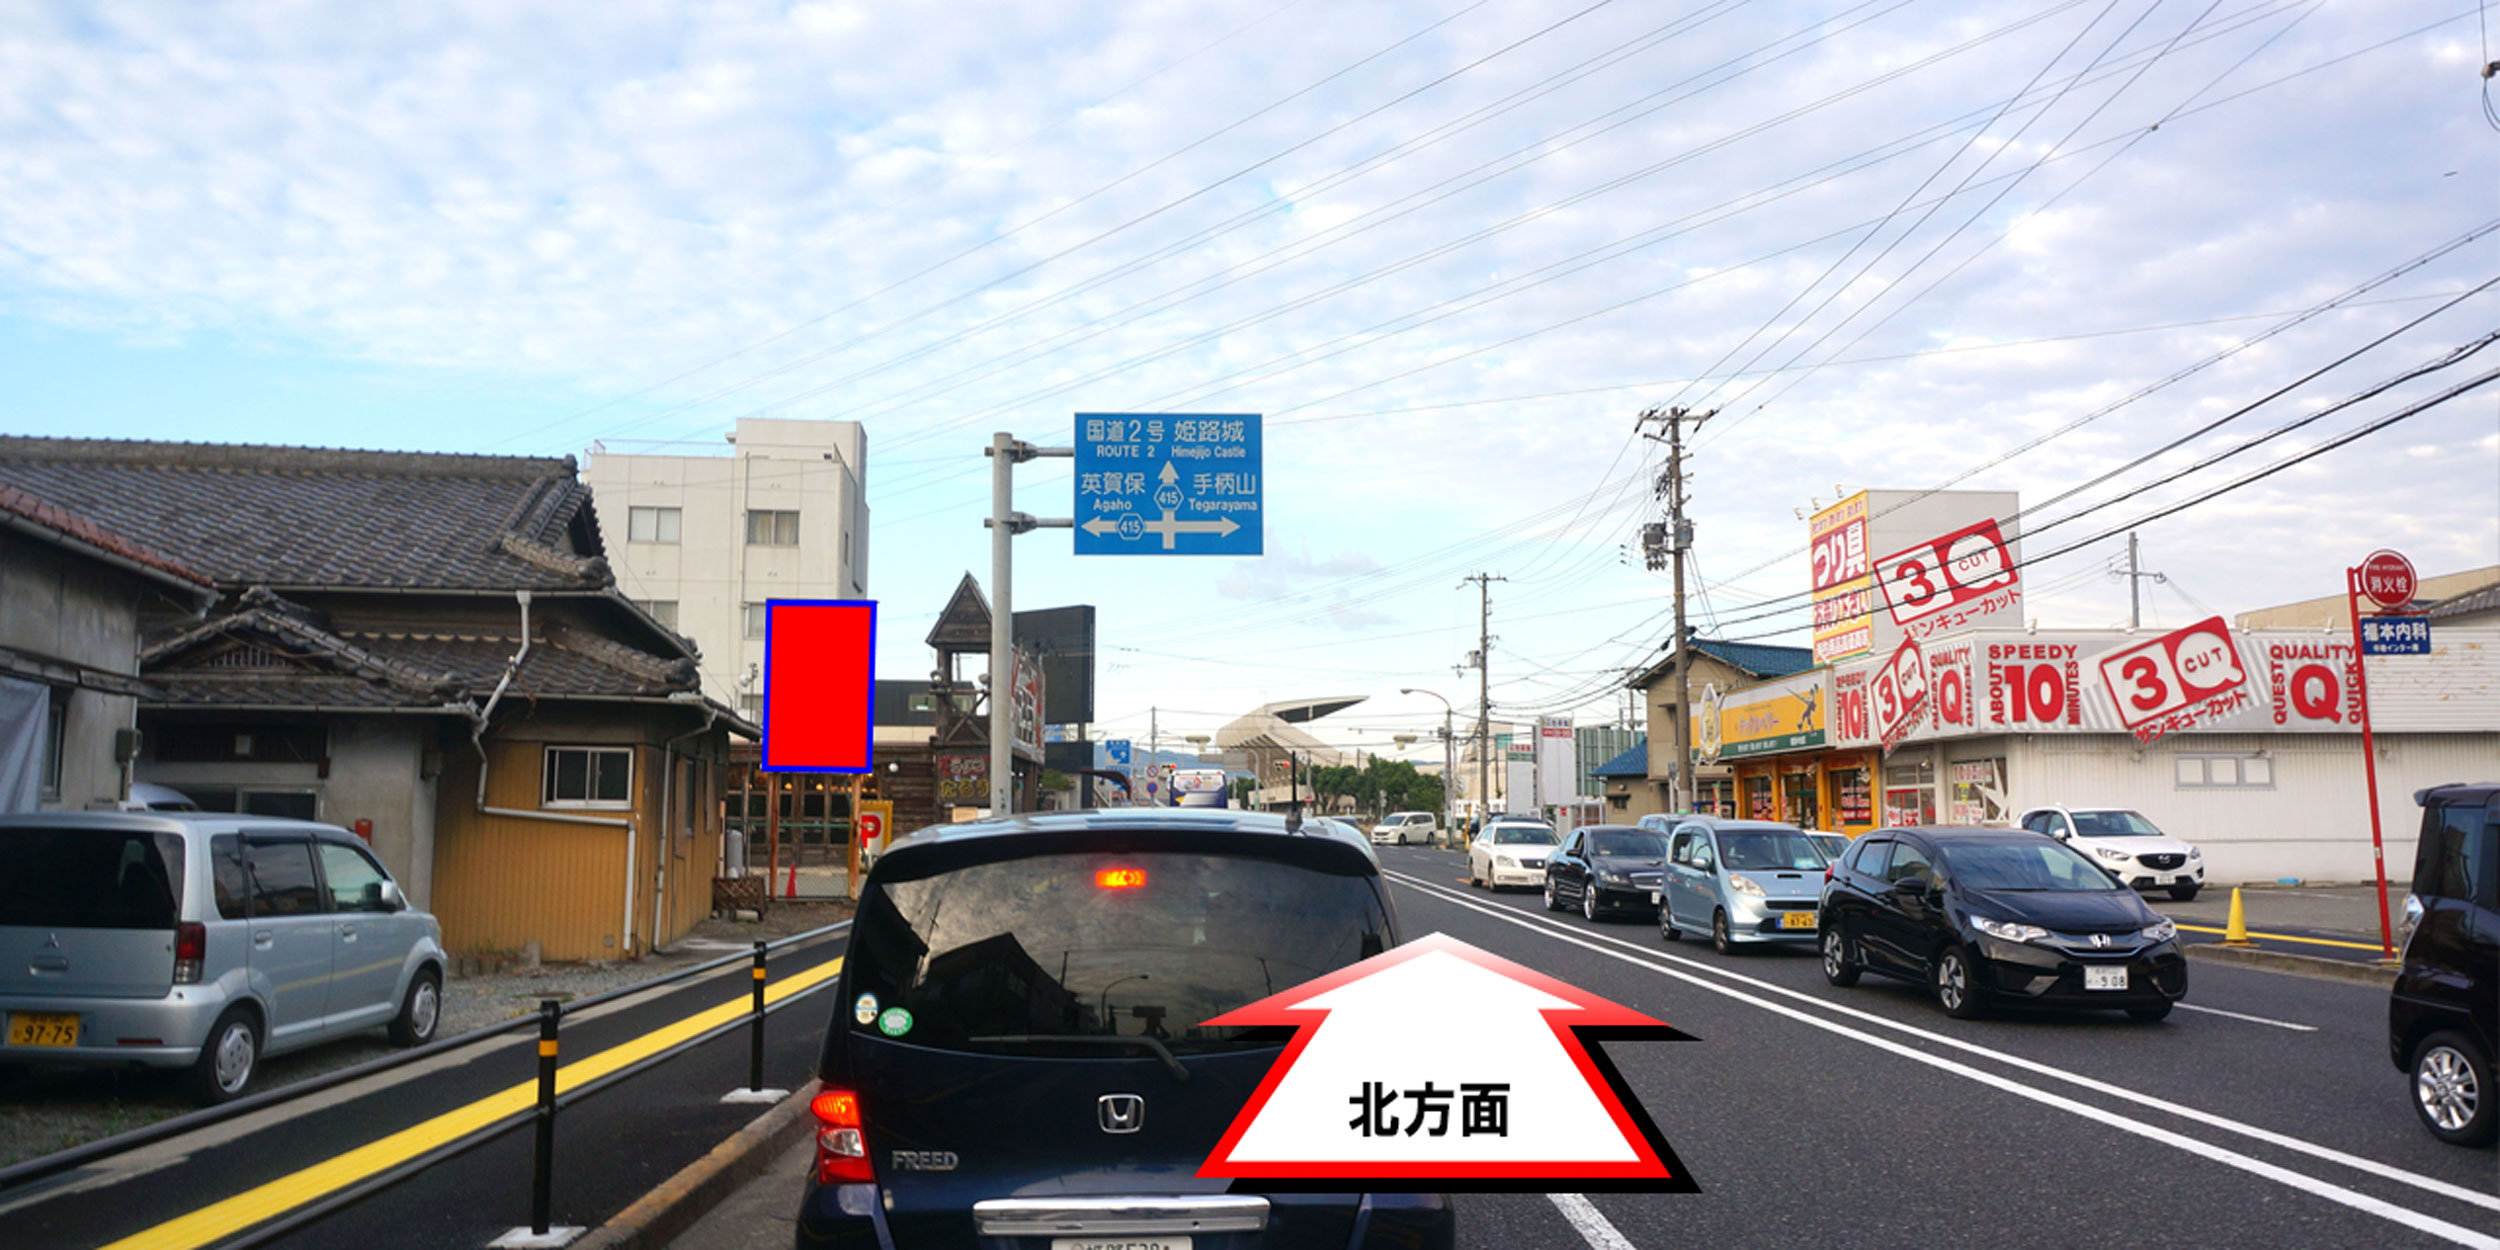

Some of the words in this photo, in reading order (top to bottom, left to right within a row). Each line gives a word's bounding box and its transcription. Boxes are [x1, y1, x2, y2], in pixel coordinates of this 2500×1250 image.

[1087, 420, 1165, 442] 国道2号
[1174, 420, 1245, 442] 姫路城
[1096, 445, 1140, 457] ROUTE
[1147, 445, 1156, 457] 2
[1214, 445, 1246, 457] Castle
[1081, 471, 1146, 495] 英賀保
[1193, 472, 1257, 495] 手柄山
[1093, 498, 1132, 512] Agaho
[1159, 491, 1178, 504] 415
[1188, 498, 1258, 512] Tegarayama
[1121, 521, 1141, 534] 415
[1813, 521, 1867, 587] つり具
[1896, 560, 1935, 606] 3
[1958, 552, 1990, 572] CUT
[2371, 576, 2408, 593] 消火栓
[2363, 622, 2428, 641] 福本内科
[1930, 646, 1971, 668] QUALITY
[1988, 644, 2078, 660] SPEEDY
[2269, 644, 2356, 660] QUALITY
[2122, 656, 2168, 711] 3
[2184, 647, 2222, 672] CUT
[1878, 675, 1897, 724] 3
[1901, 661, 1918, 686] CUT
[1940, 669, 1963, 726] Q
[1988, 661, 2006, 725] ABOUT
[2004, 663, 2065, 723] 10
[2064, 661, 2081, 725] MINUTES
[2270, 660, 2288, 725] QUEST
[2290, 663, 2343, 724] Q
[2344, 661, 2362, 725] QUICK
[1841, 689, 1862, 739] 10
[2133, 690, 2248, 745] サンキューカット
[892, 1150, 959, 1171] FREED
